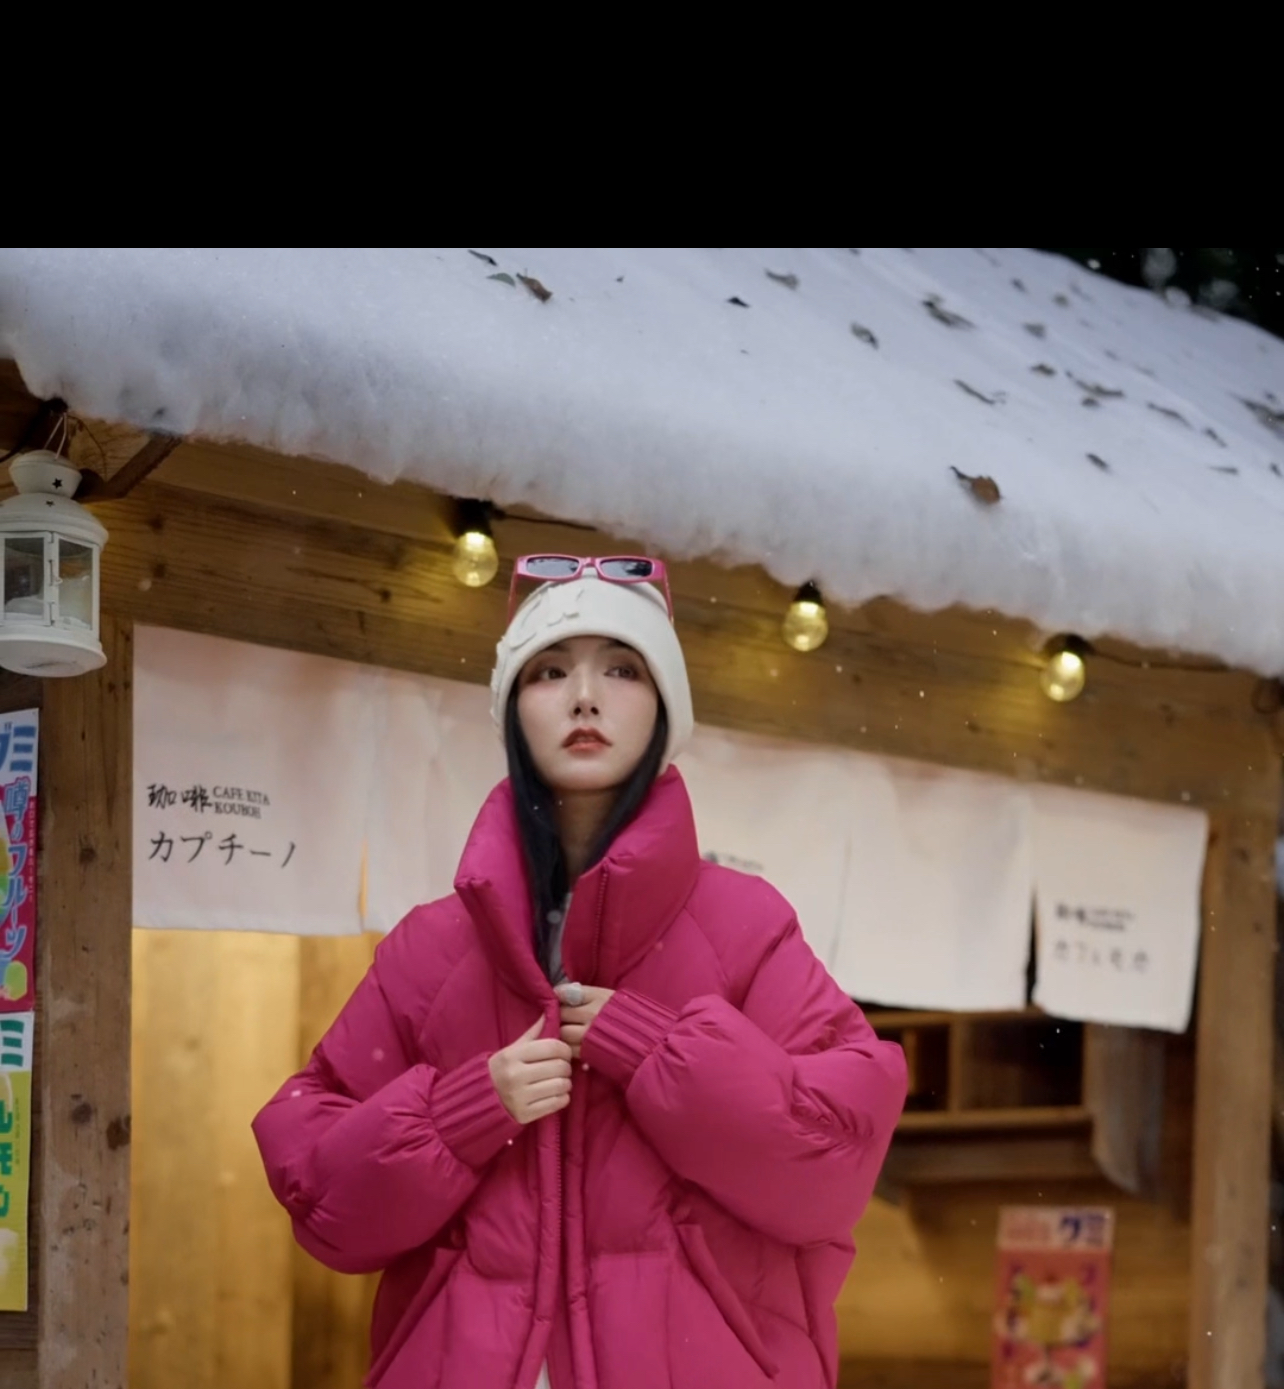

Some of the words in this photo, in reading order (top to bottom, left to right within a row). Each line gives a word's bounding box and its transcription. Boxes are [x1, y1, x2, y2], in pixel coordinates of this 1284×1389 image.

[213, 785, 245, 801] CAFE
[149, 831, 296, 869] カプチーノ
